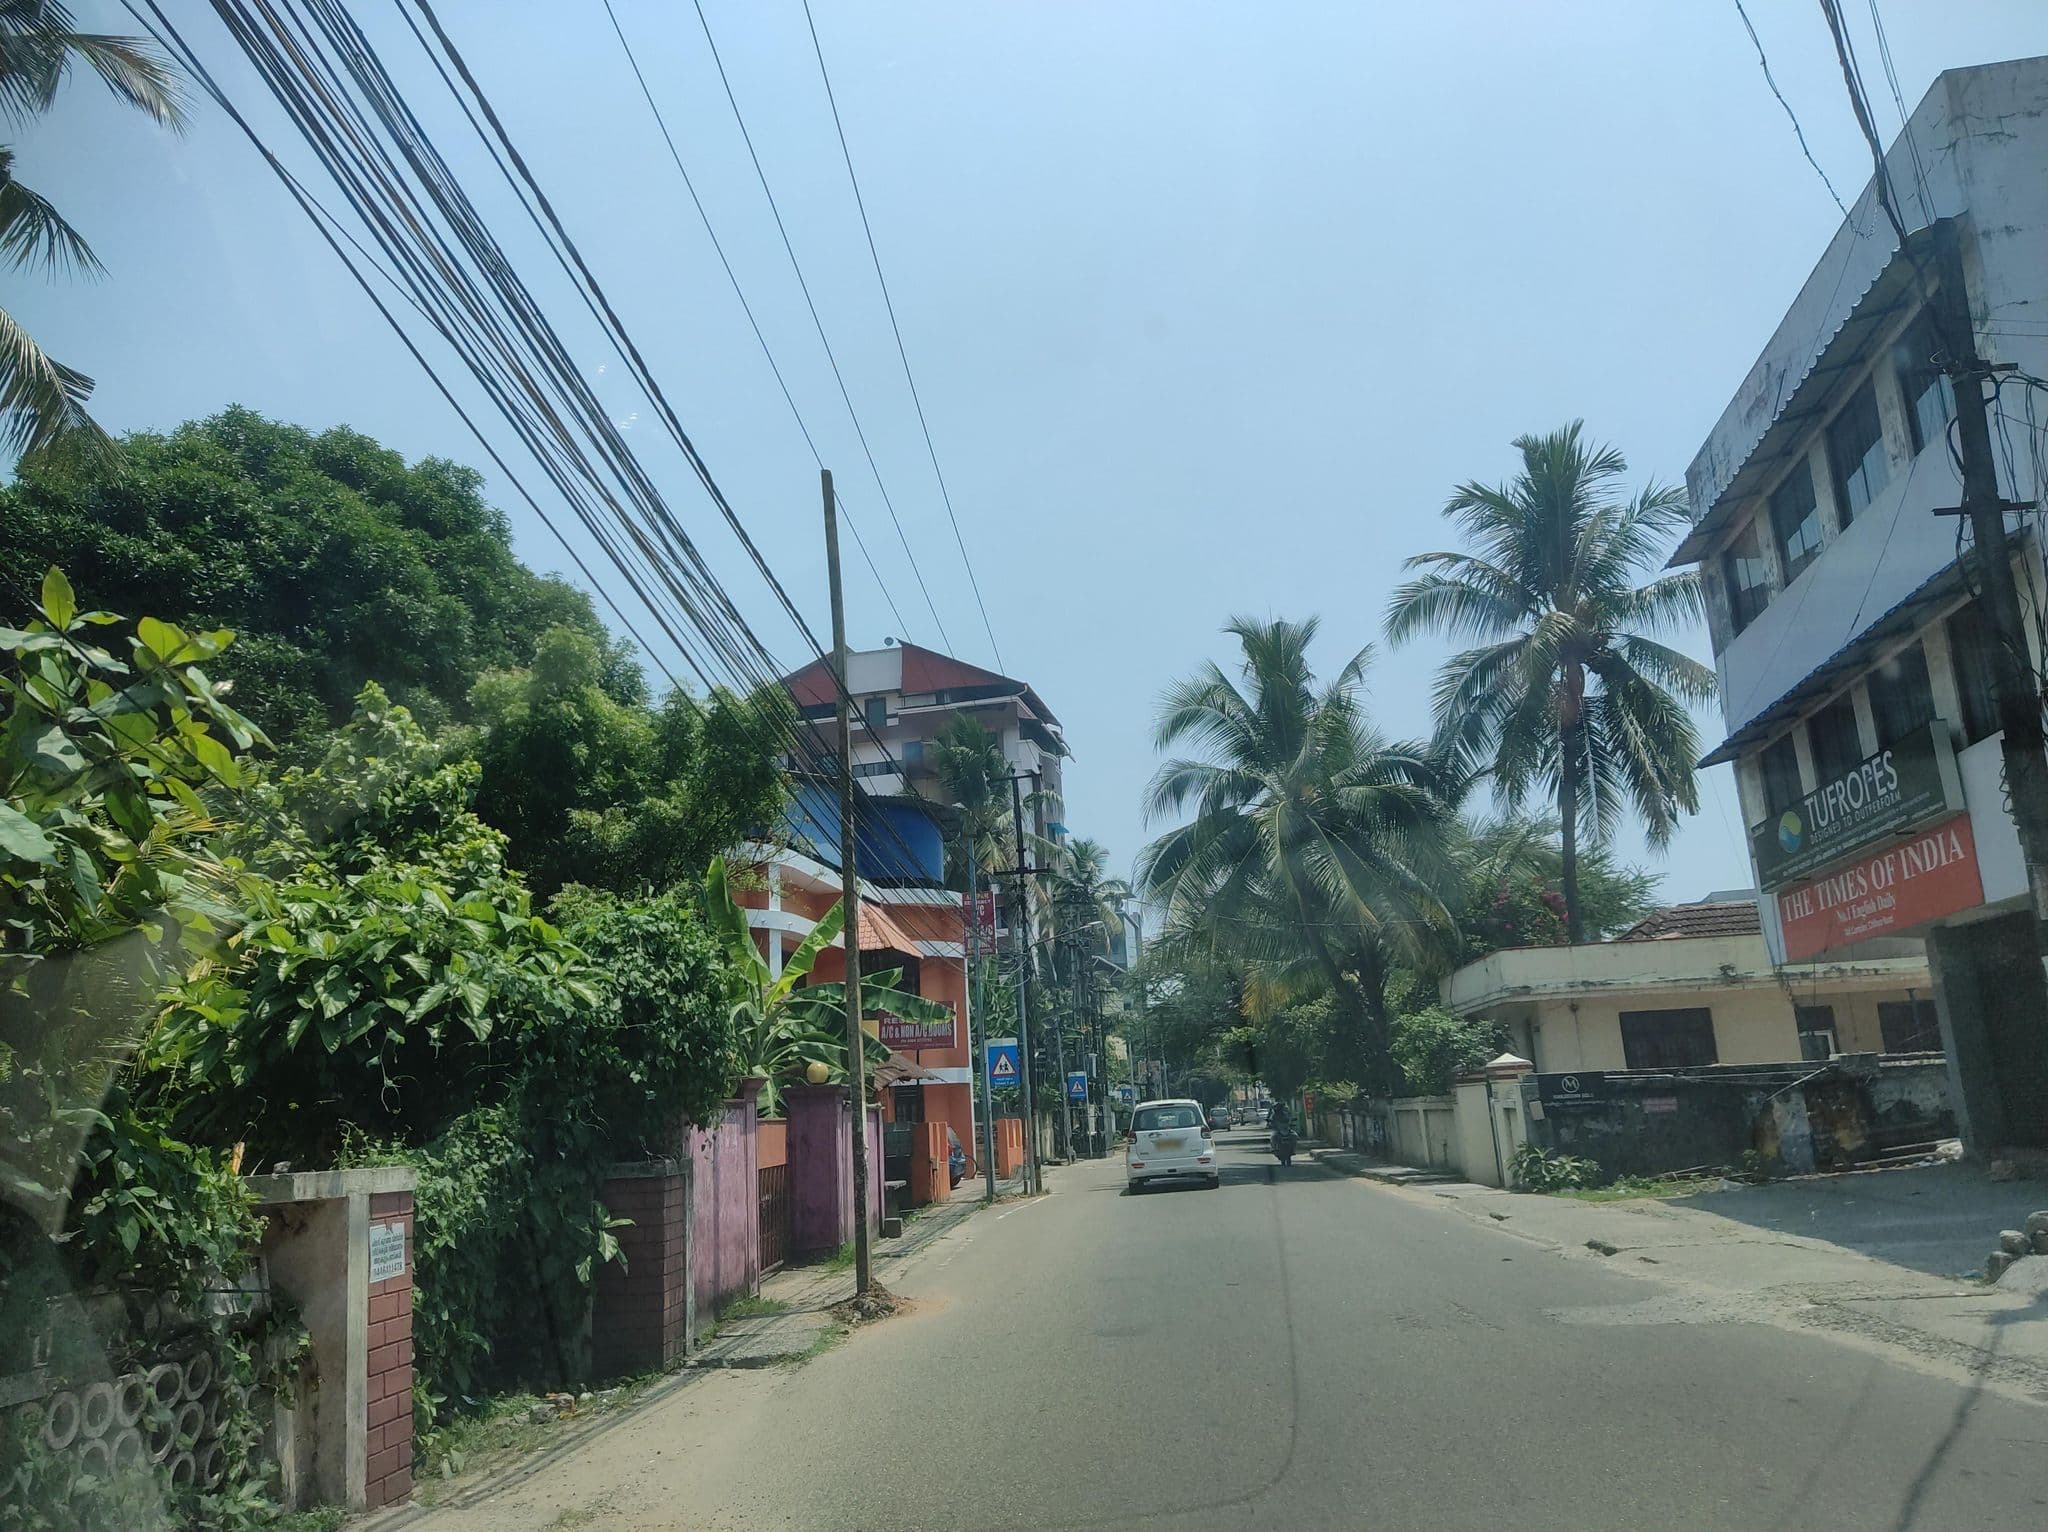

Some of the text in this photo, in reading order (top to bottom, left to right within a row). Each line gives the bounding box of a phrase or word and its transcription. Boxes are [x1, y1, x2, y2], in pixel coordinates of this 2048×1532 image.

[1804, 750, 1898, 831] TUFROPES
[1810, 792, 1901, 845] DESIGNED TO OUTPERFORM
[1782, 887, 1814, 922] THE
[1815, 866, 1868, 911] TIMES
[1870, 854, 1897, 890] OF
[1900, 829, 1966, 880] INDIA
[881, 1025, 894, 1039] A/C
[900, 1023, 915, 1039] NON
